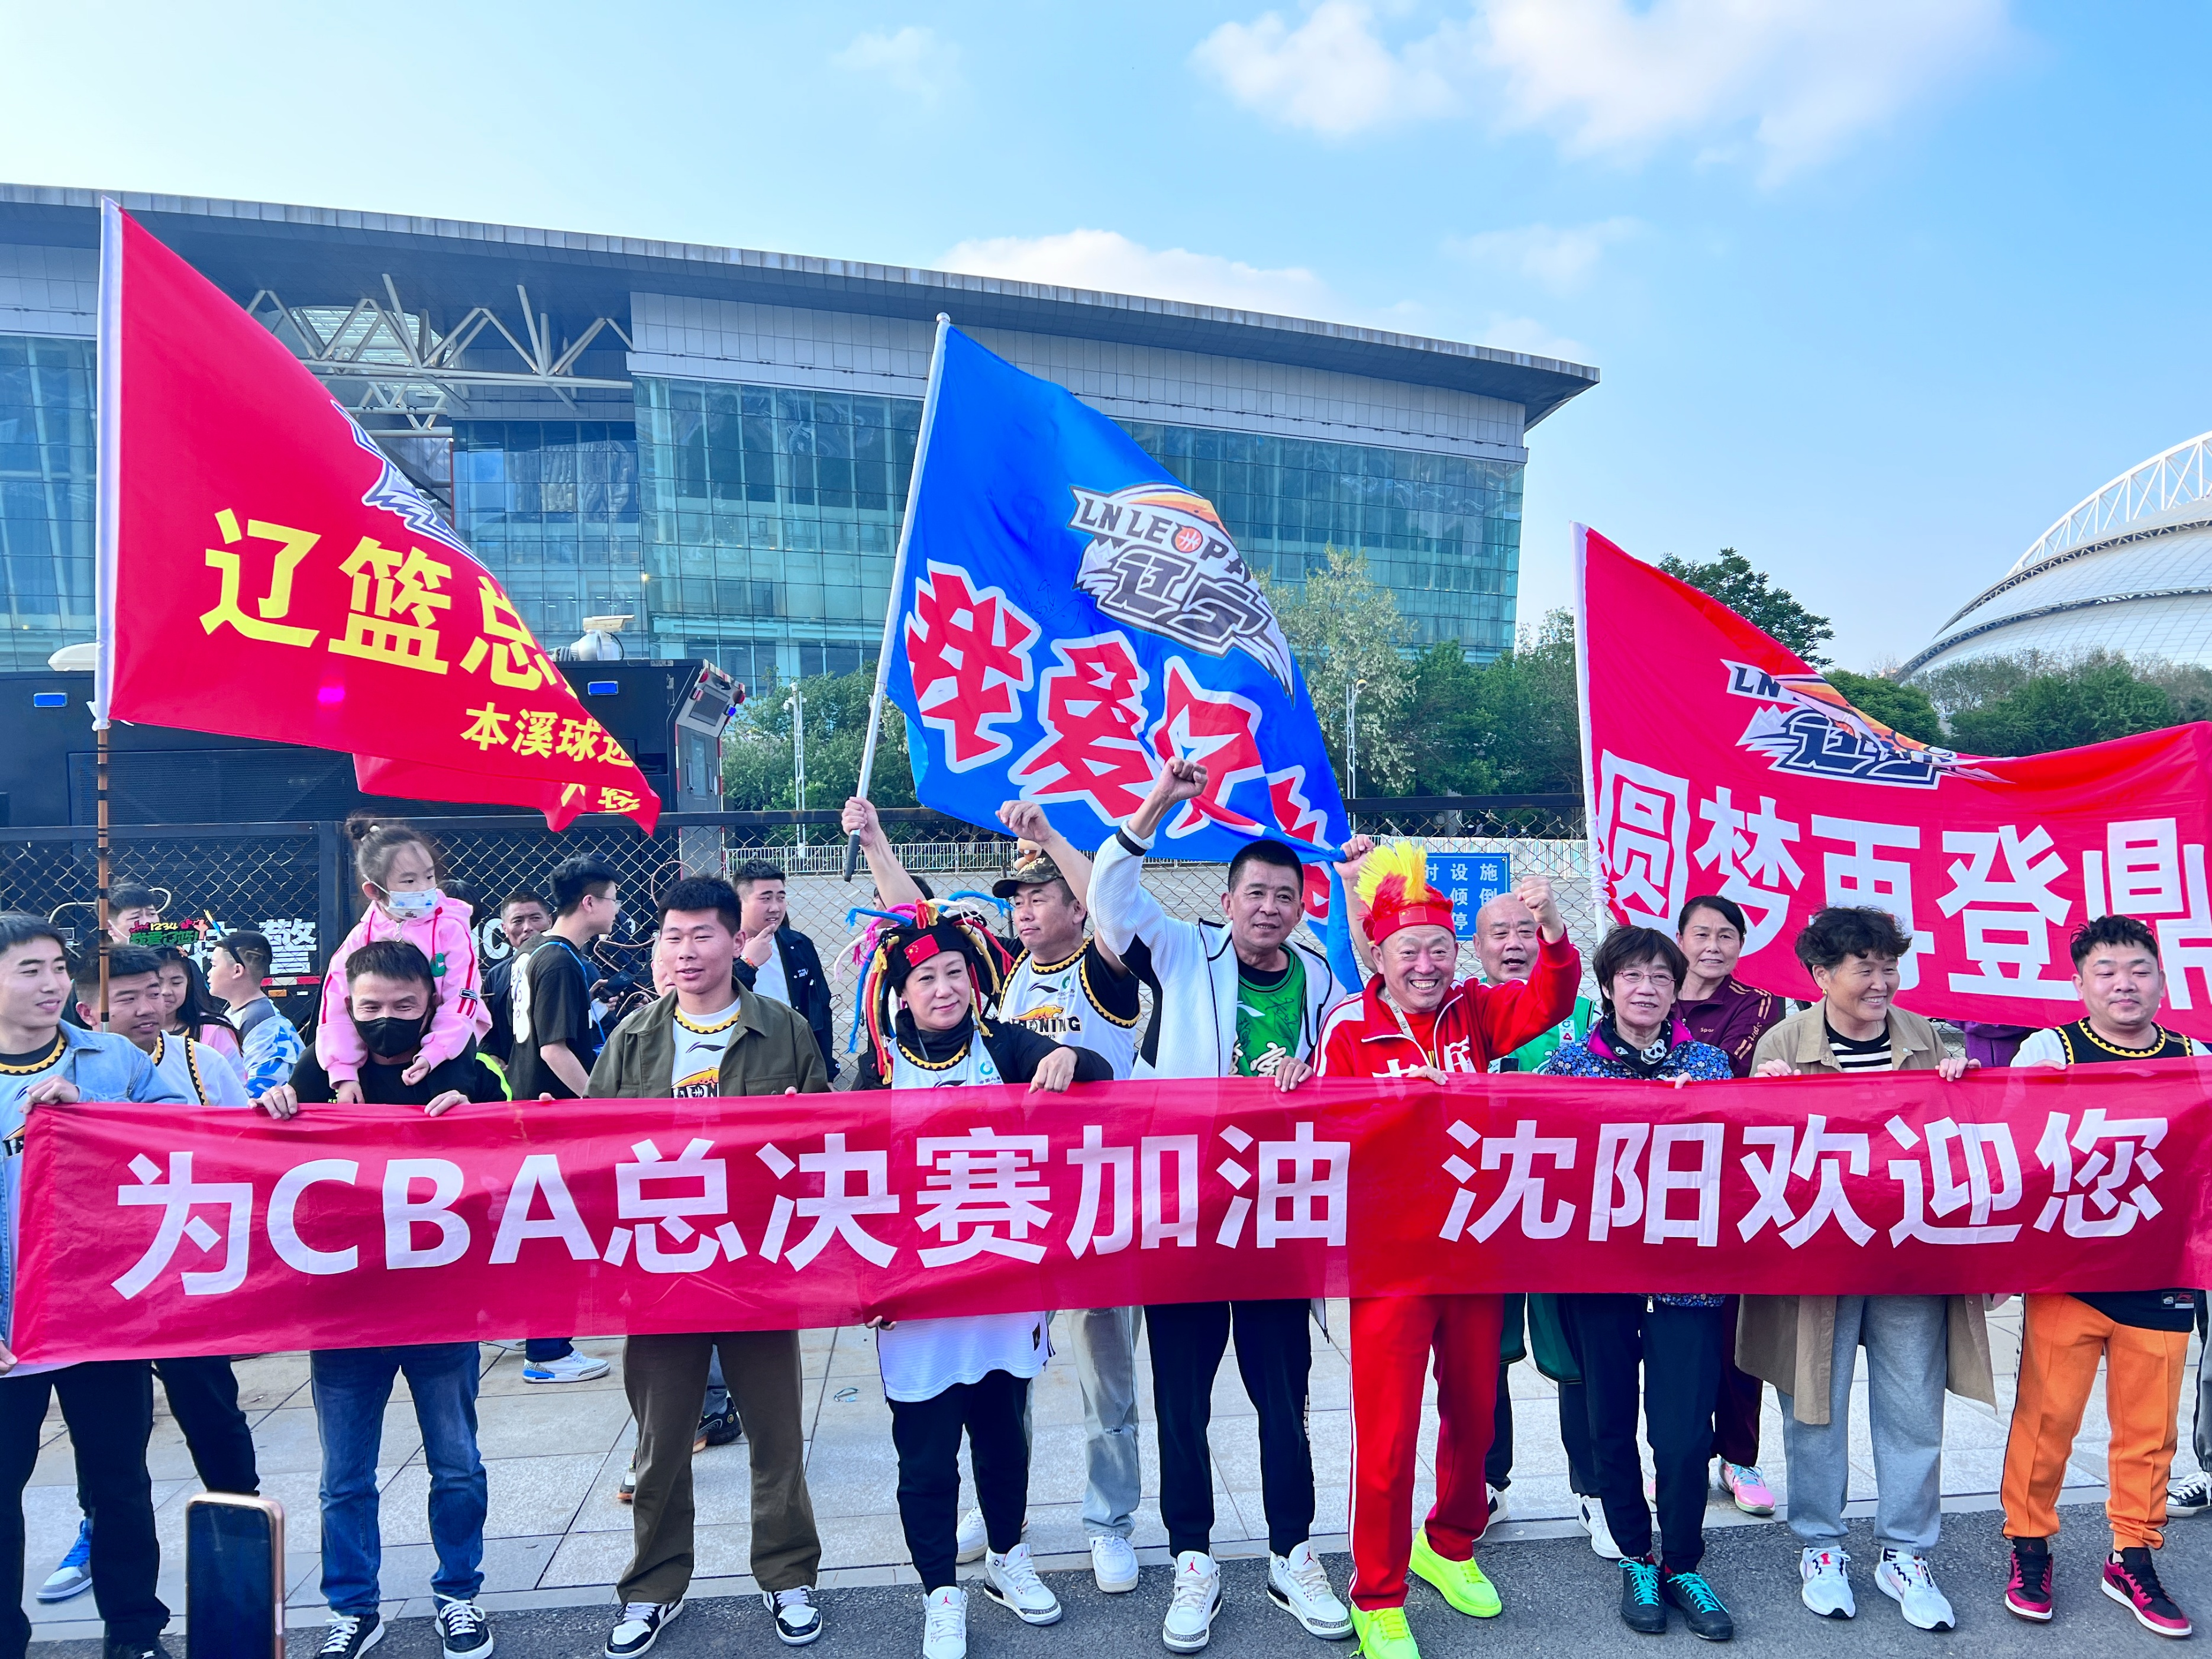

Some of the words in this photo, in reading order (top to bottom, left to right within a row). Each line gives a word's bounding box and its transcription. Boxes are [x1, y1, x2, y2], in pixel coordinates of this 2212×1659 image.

[199, 508, 577, 699] 辽篮总
[1452, 912, 1468, 931] 停
[111, 1122, 1350, 1300] 为CBA总决赛加油
[1439, 1108, 2168, 1249] 沈阳欢迎您
